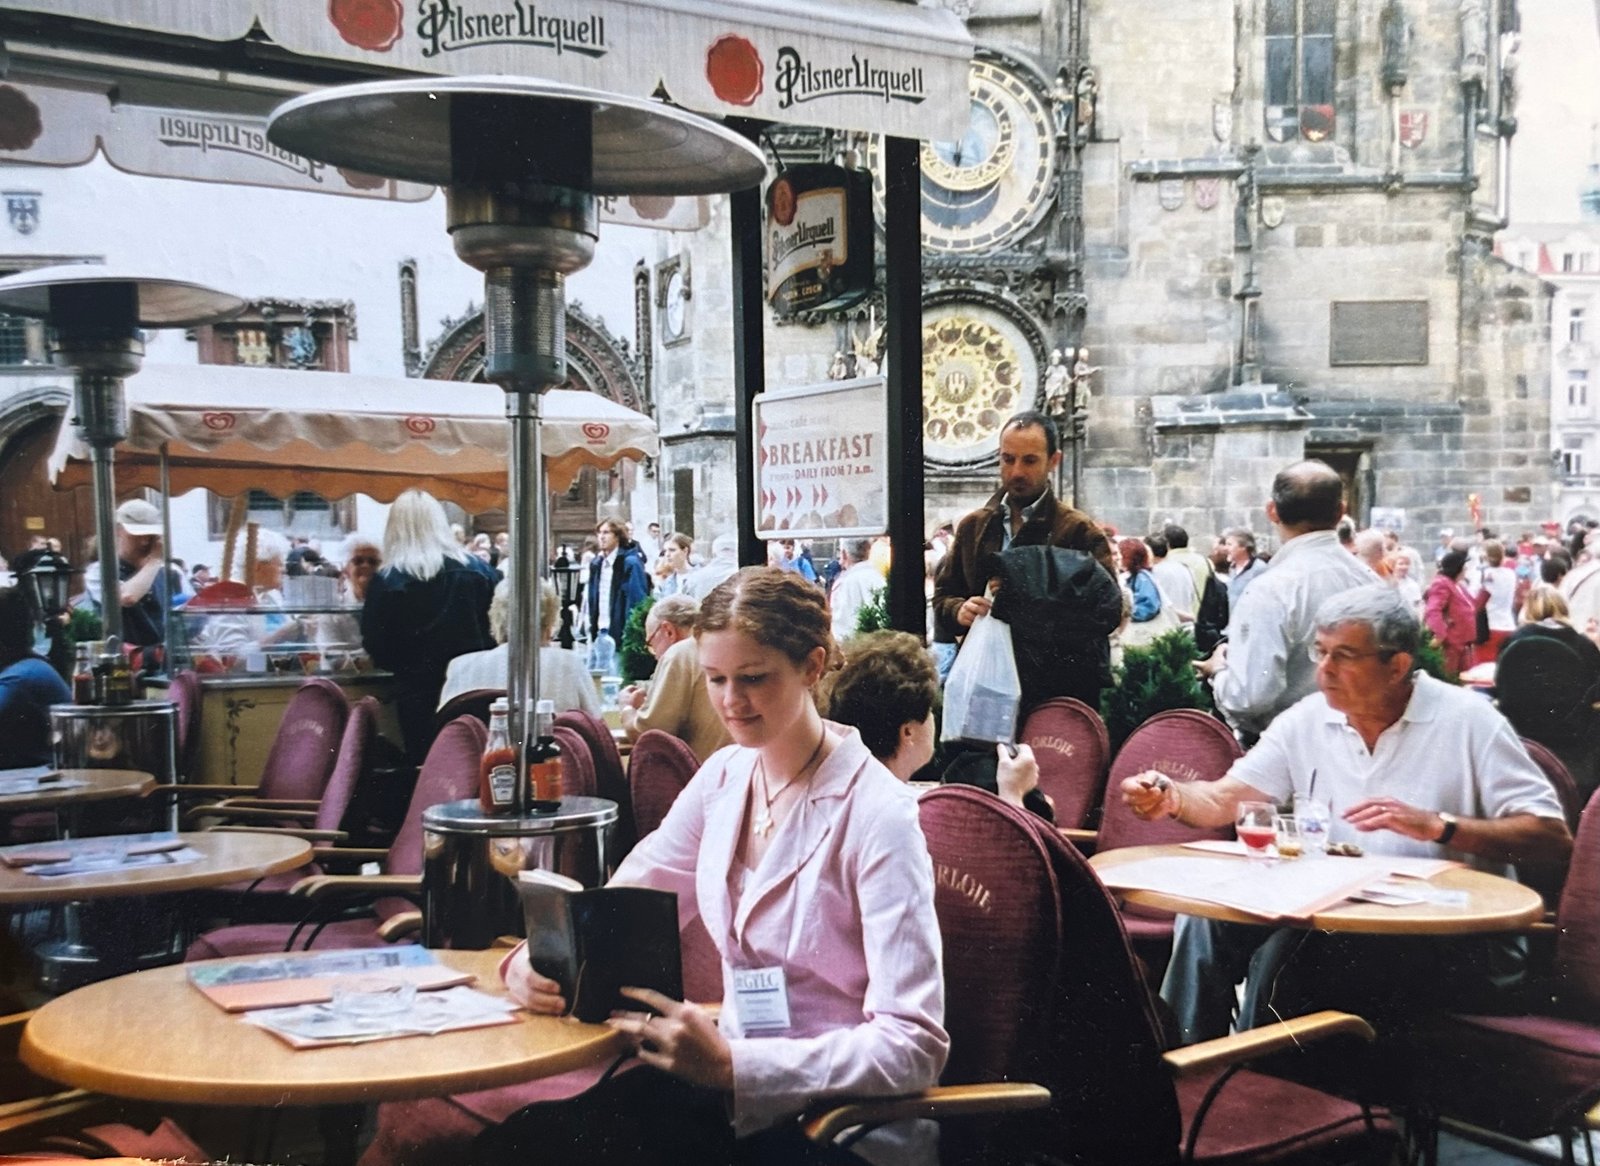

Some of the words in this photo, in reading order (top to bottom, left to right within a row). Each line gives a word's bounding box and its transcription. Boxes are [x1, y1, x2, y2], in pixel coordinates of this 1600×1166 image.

[417, 0, 515, 58] Pilsner
[514, 0, 605, 56] Urquell
[775, 46, 853, 109] Pilsner
[852, 53, 923, 104] Urquell
[797, 216, 834, 248] Urquell
[769, 433, 873, 466] BREAKFAST
[795, 468, 817, 480] DAILY
[820, 465, 845, 477] FROM
[847, 465, 852, 475] 7
[855, 465, 874, 475] a.m.
